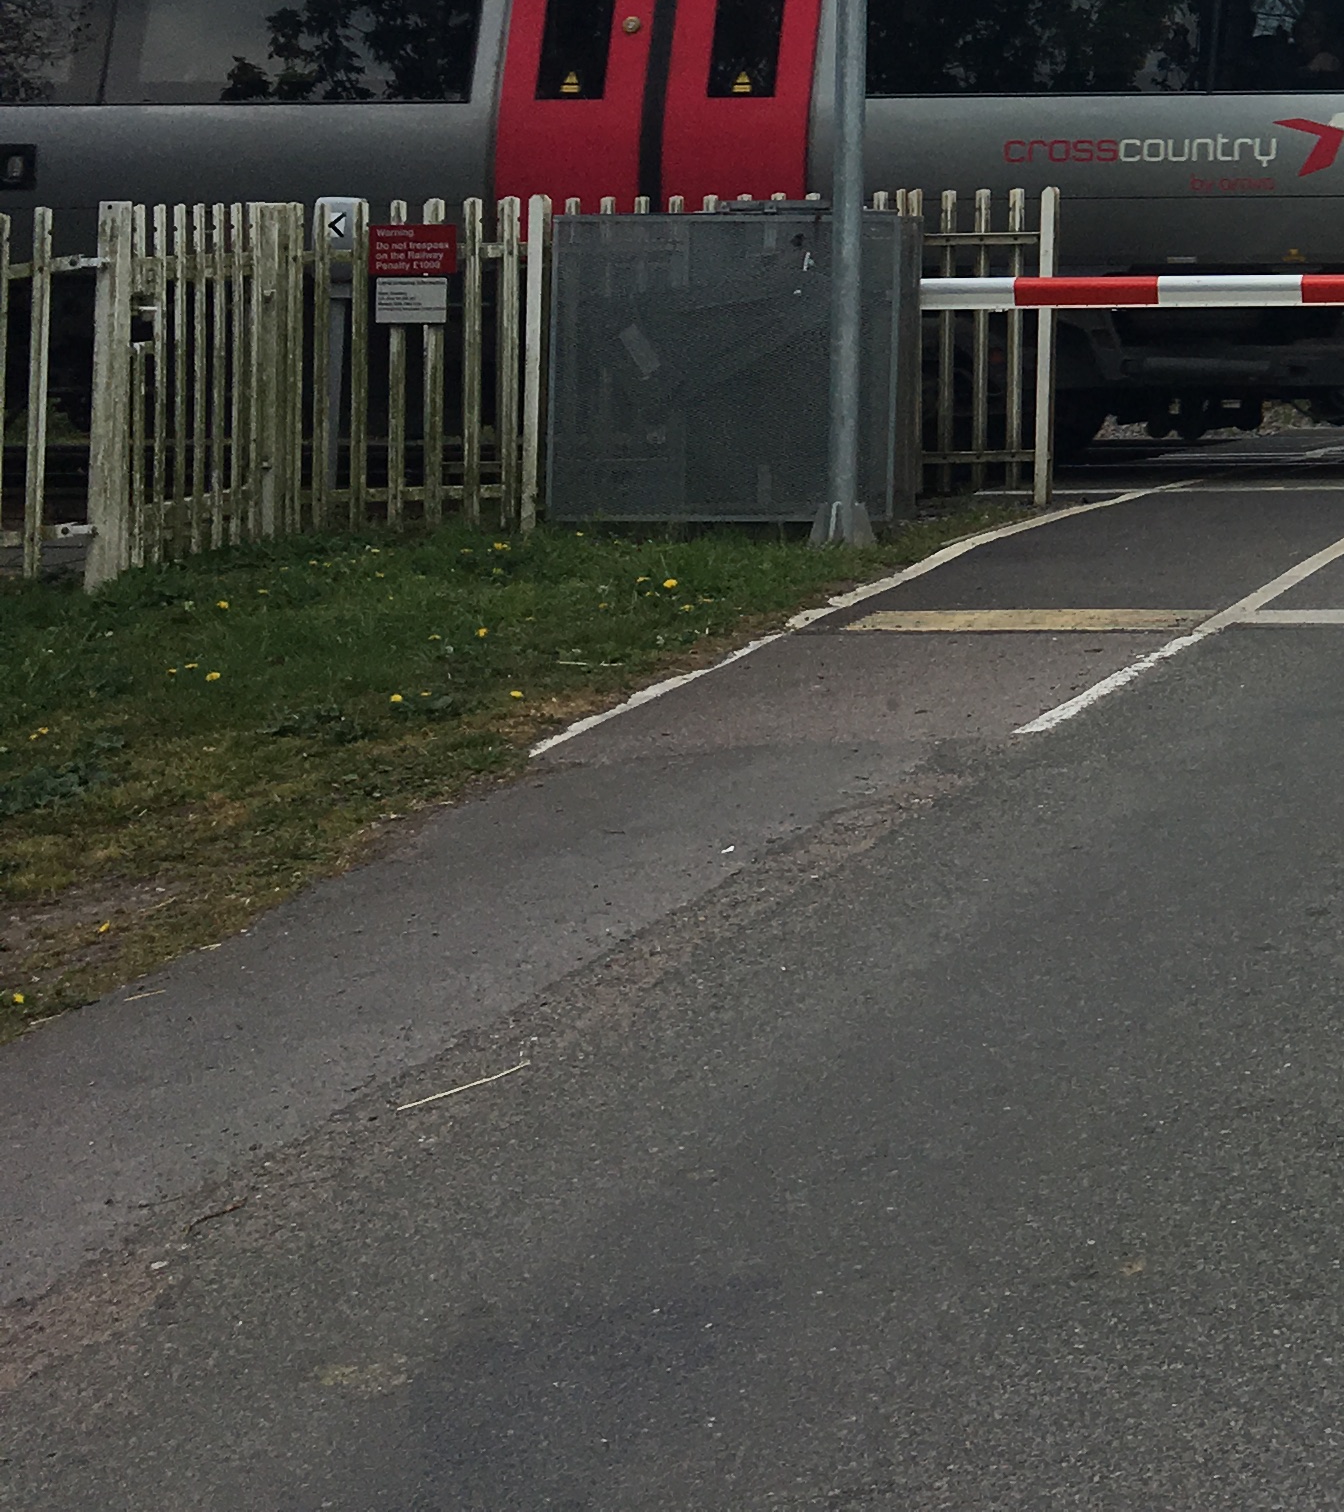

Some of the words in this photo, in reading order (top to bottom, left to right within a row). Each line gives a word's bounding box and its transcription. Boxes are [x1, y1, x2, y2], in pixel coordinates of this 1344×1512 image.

[1003, 134, 1278, 167] crosscountry
[376, 229, 414, 238] Warning
[376, 242, 389, 250] Do
[392, 242, 407, 250] not
[375, 252, 388, 260] on
[390, 251, 405, 260] the
